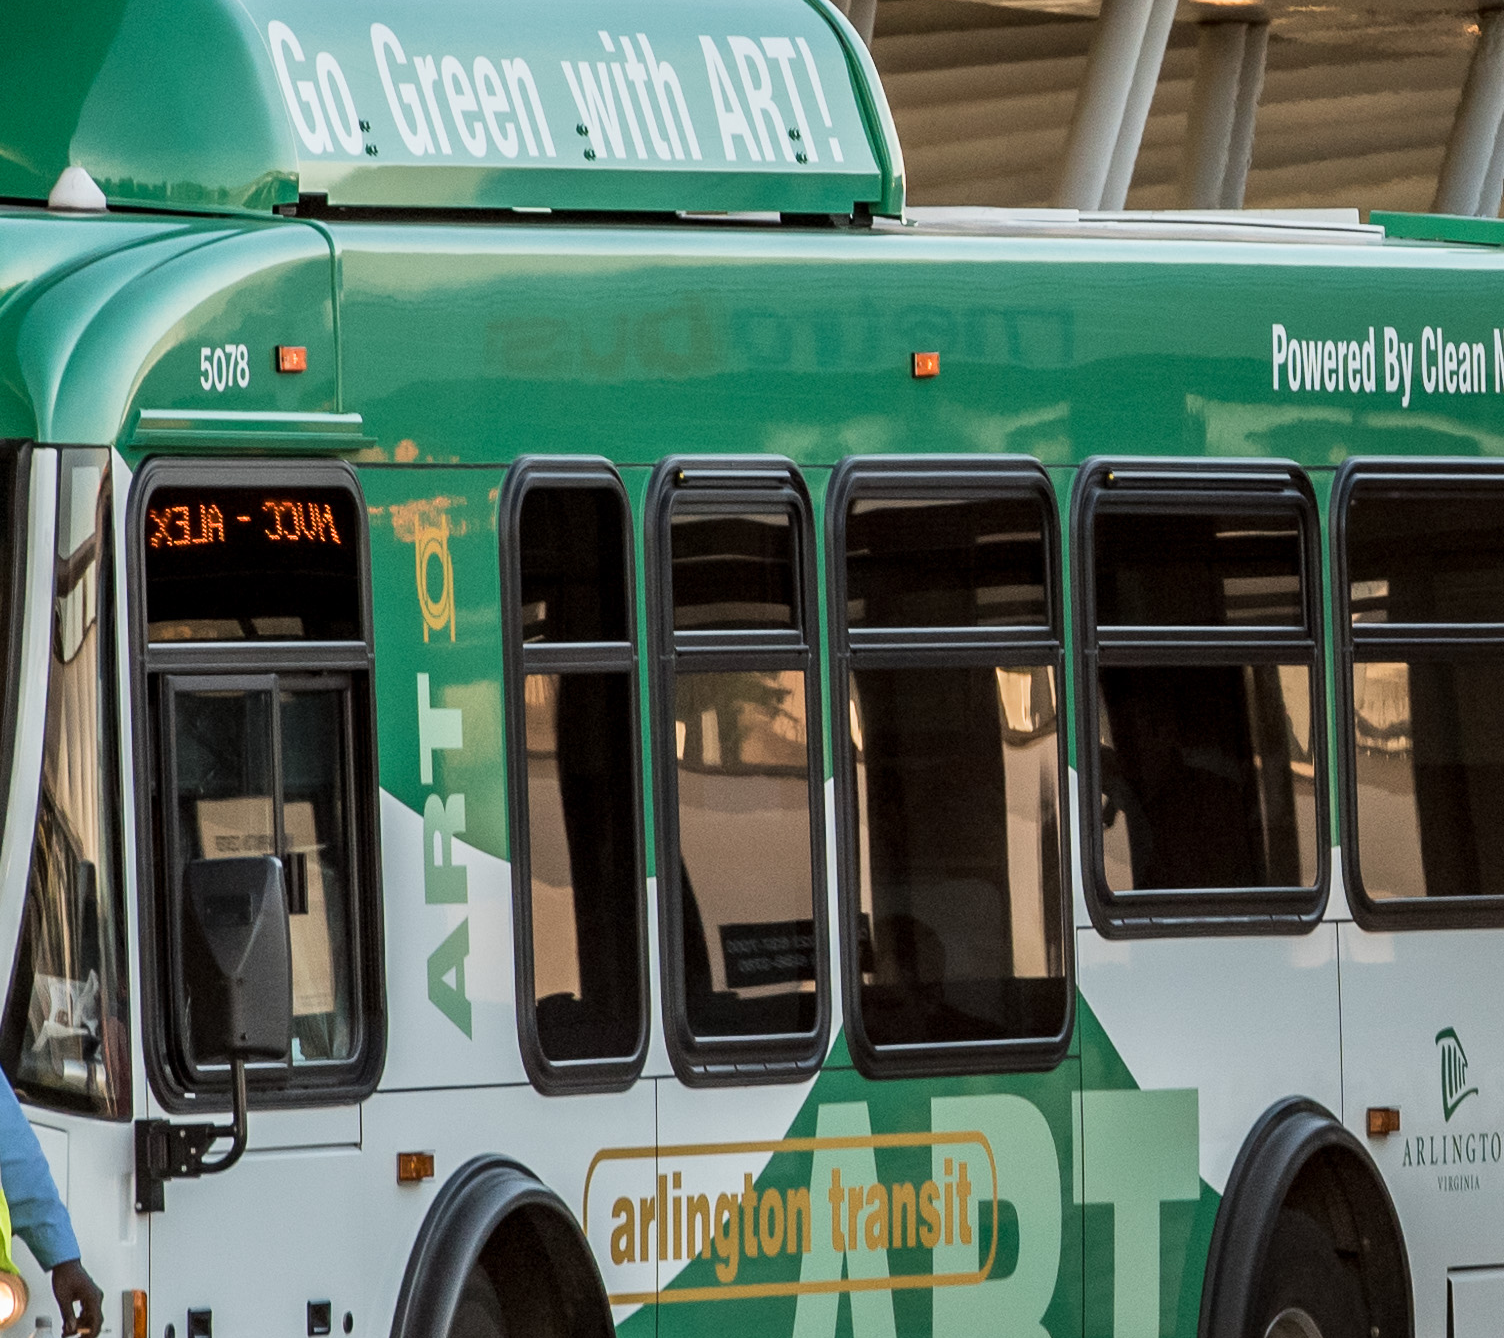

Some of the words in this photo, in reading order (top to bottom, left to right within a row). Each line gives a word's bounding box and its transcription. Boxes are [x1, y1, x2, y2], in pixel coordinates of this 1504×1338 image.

[267, 19, 365, 156] Go
[370, 23, 557, 159] Green
[561, 30, 703, 162] with
[698, 33, 846, 164] ART!
[200, 344, 250, 392] 5078
[1272, 324, 1376, 394] Powered
[1384, 326, 1414, 408] By
[1421, 325, 1487, 394] Clean
[417, 673, 473, 1042] ART
[610, 1172, 813, 1283] arlington
[828, 1157, 973, 1253] transit
[1437, 1174, 1481, 1192] VIRGINIA
